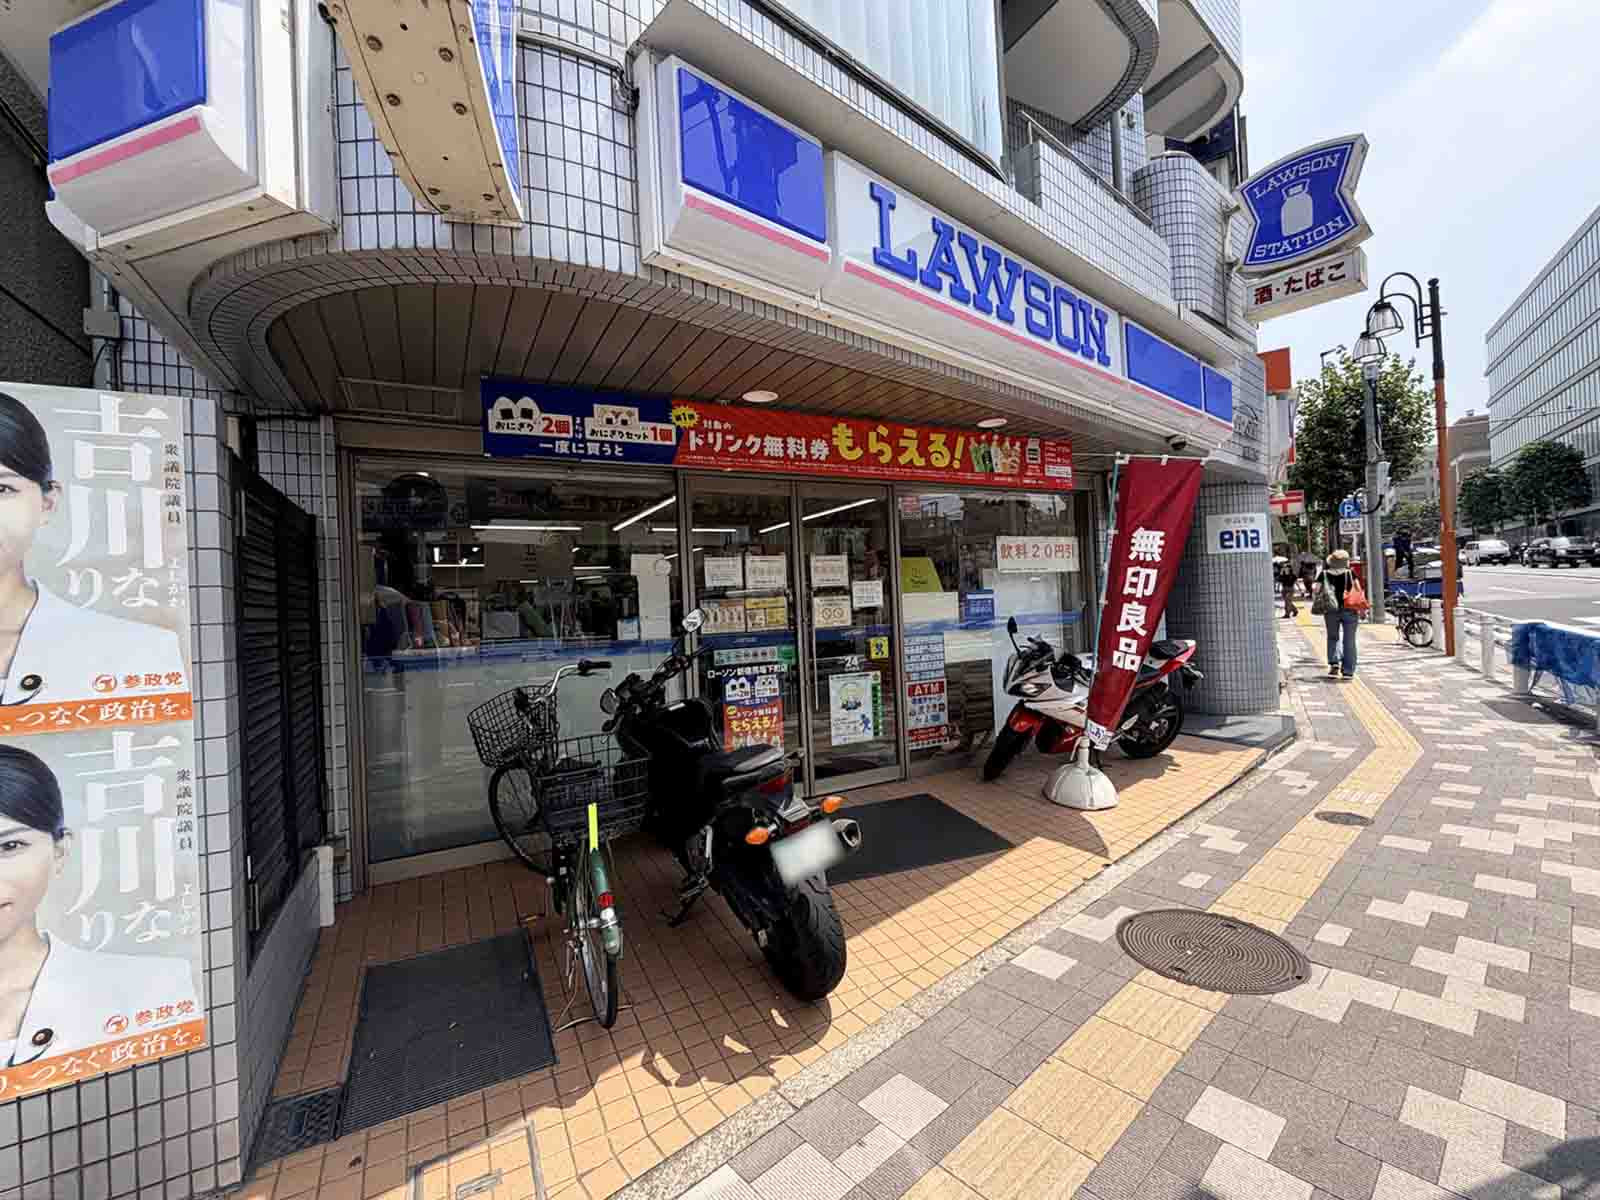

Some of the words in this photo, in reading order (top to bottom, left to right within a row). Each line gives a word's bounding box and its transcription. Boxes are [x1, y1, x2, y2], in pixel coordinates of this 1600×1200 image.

[1253, 153, 1341, 200] LAWSON
[1254, 215, 1346, 258] STATION
[870, 181, 1111, 367] LAWSON
[1254, 261, 1347, 305] 酒・たばこ
[495, 421, 534, 433] おにぎり
[542, 417, 571, 434] 2個
[590, 428, 649, 441] おにぎりセット
[651, 427, 673, 442] 1個
[689, 429, 830, 461] ドリンク無料券
[832, 422, 965, 469] もらえる!
[539, 440, 624, 457] 一度に買うと
[1220, 529, 1260, 549] ena
[65, 566, 160, 609] りな
[1112, 527, 1165, 673] 無印良品
[124, 672, 183, 689] 参政党
[914, 683, 939, 696] ATM
[80, 901, 172, 951] りな
[134, 999, 195, 1025] 参政党
